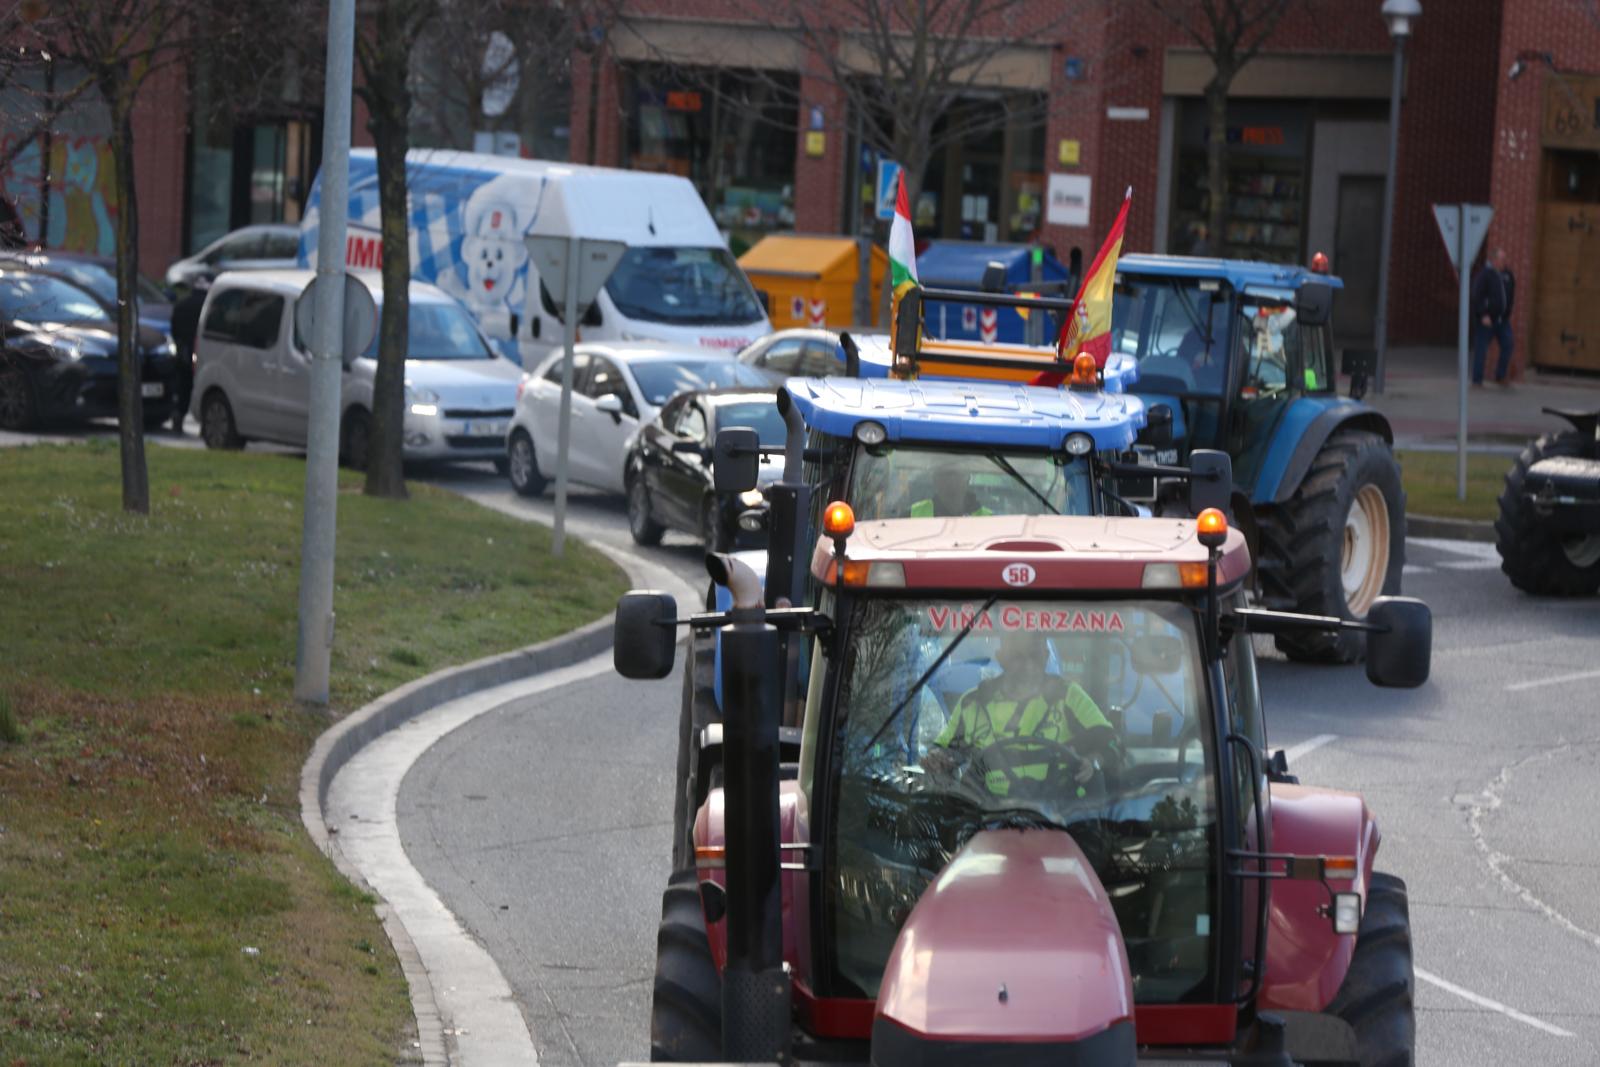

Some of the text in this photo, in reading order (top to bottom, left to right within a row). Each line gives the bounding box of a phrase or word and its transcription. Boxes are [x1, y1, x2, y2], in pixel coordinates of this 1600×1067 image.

[1009, 567, 1030, 583] 58
[928, 602, 1124, 631] VIÑA CERZANA
